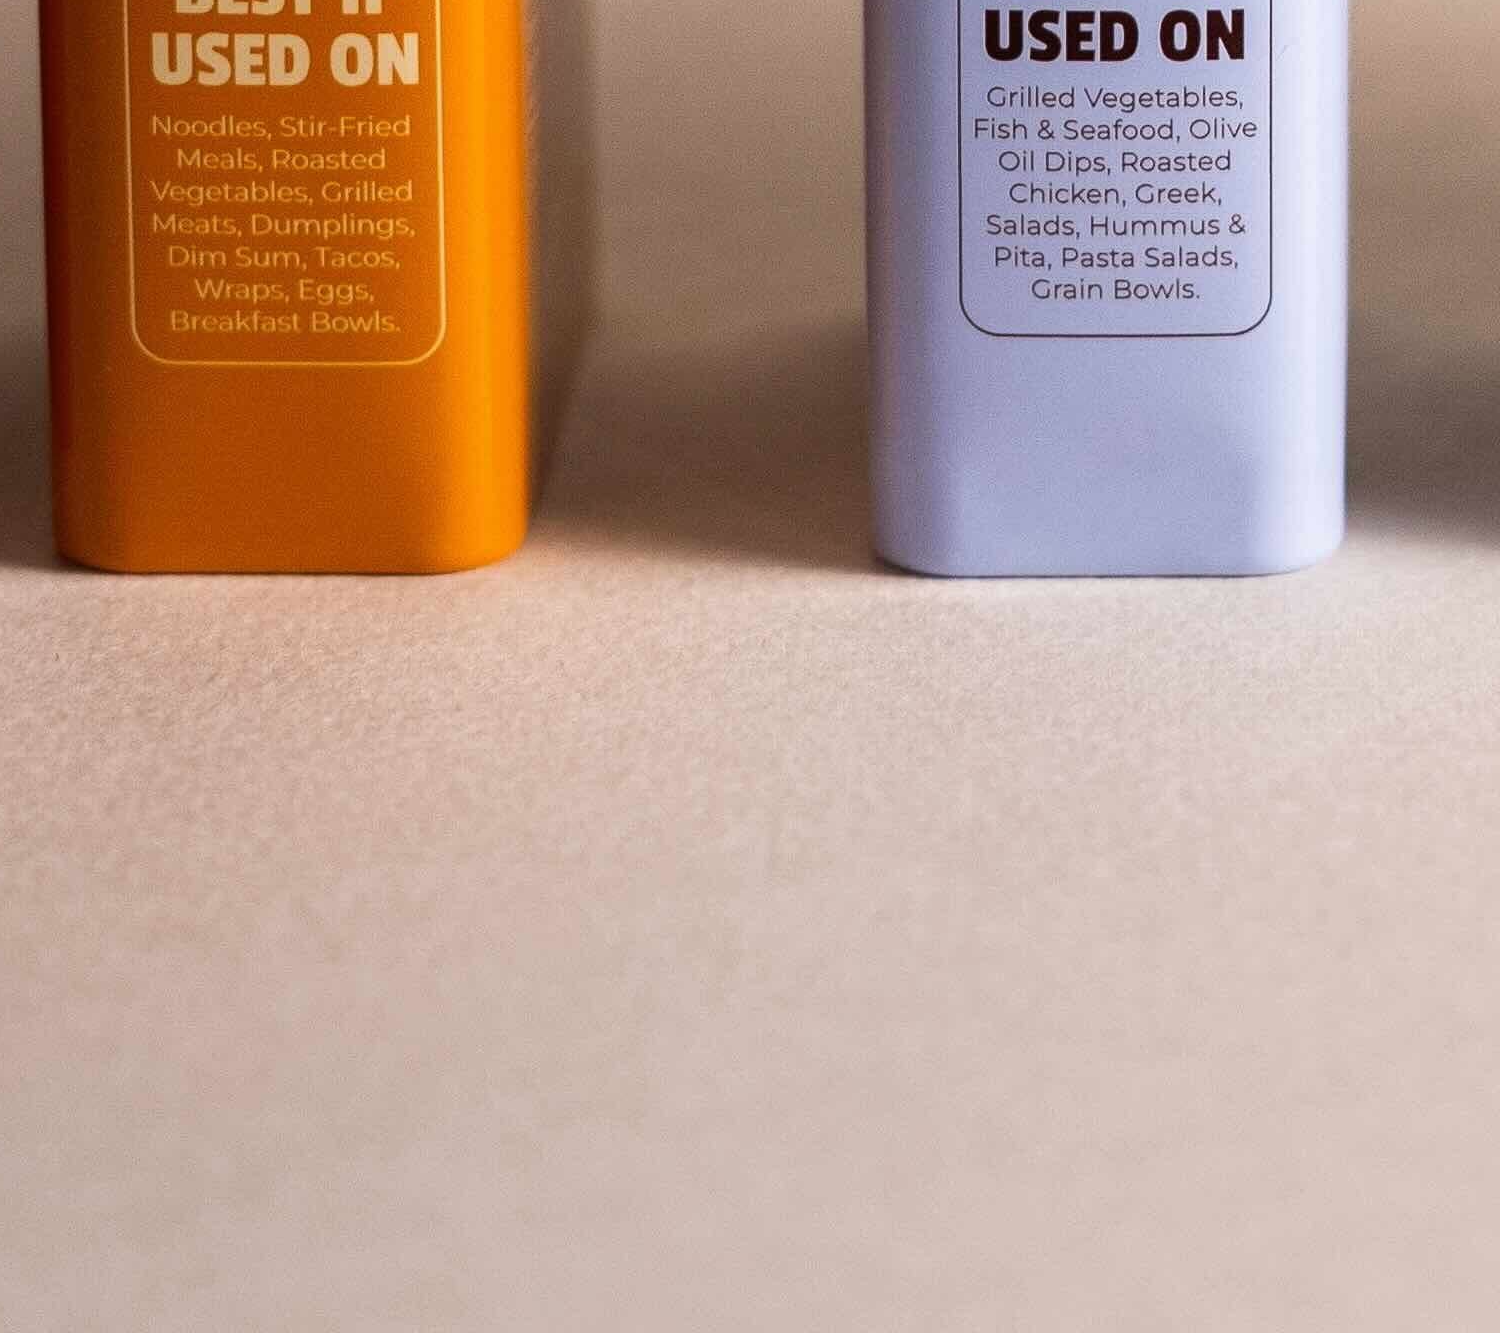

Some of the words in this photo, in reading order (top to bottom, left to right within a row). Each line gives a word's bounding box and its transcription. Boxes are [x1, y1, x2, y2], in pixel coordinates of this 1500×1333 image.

[984, 8, 1139, 62] USED
[1158, 8, 1246, 62] ON
[150, 32, 311, 86] USED
[329, 32, 420, 86] ON
[986, 85, 1075, 109] Grilled
[1083, 85, 1244, 114] Vegetables,
[974, 117, 1028, 140] Fish
[1037, 119, 1055, 141] &
[1063, 118, 1181, 143] Seafood,
[1189, 117, 1258, 140] Olive
[998, 150, 1035, 172] Oil
[1045, 150, 1111, 177] Dips,
[1121, 149, 1231, 173] Roasted
